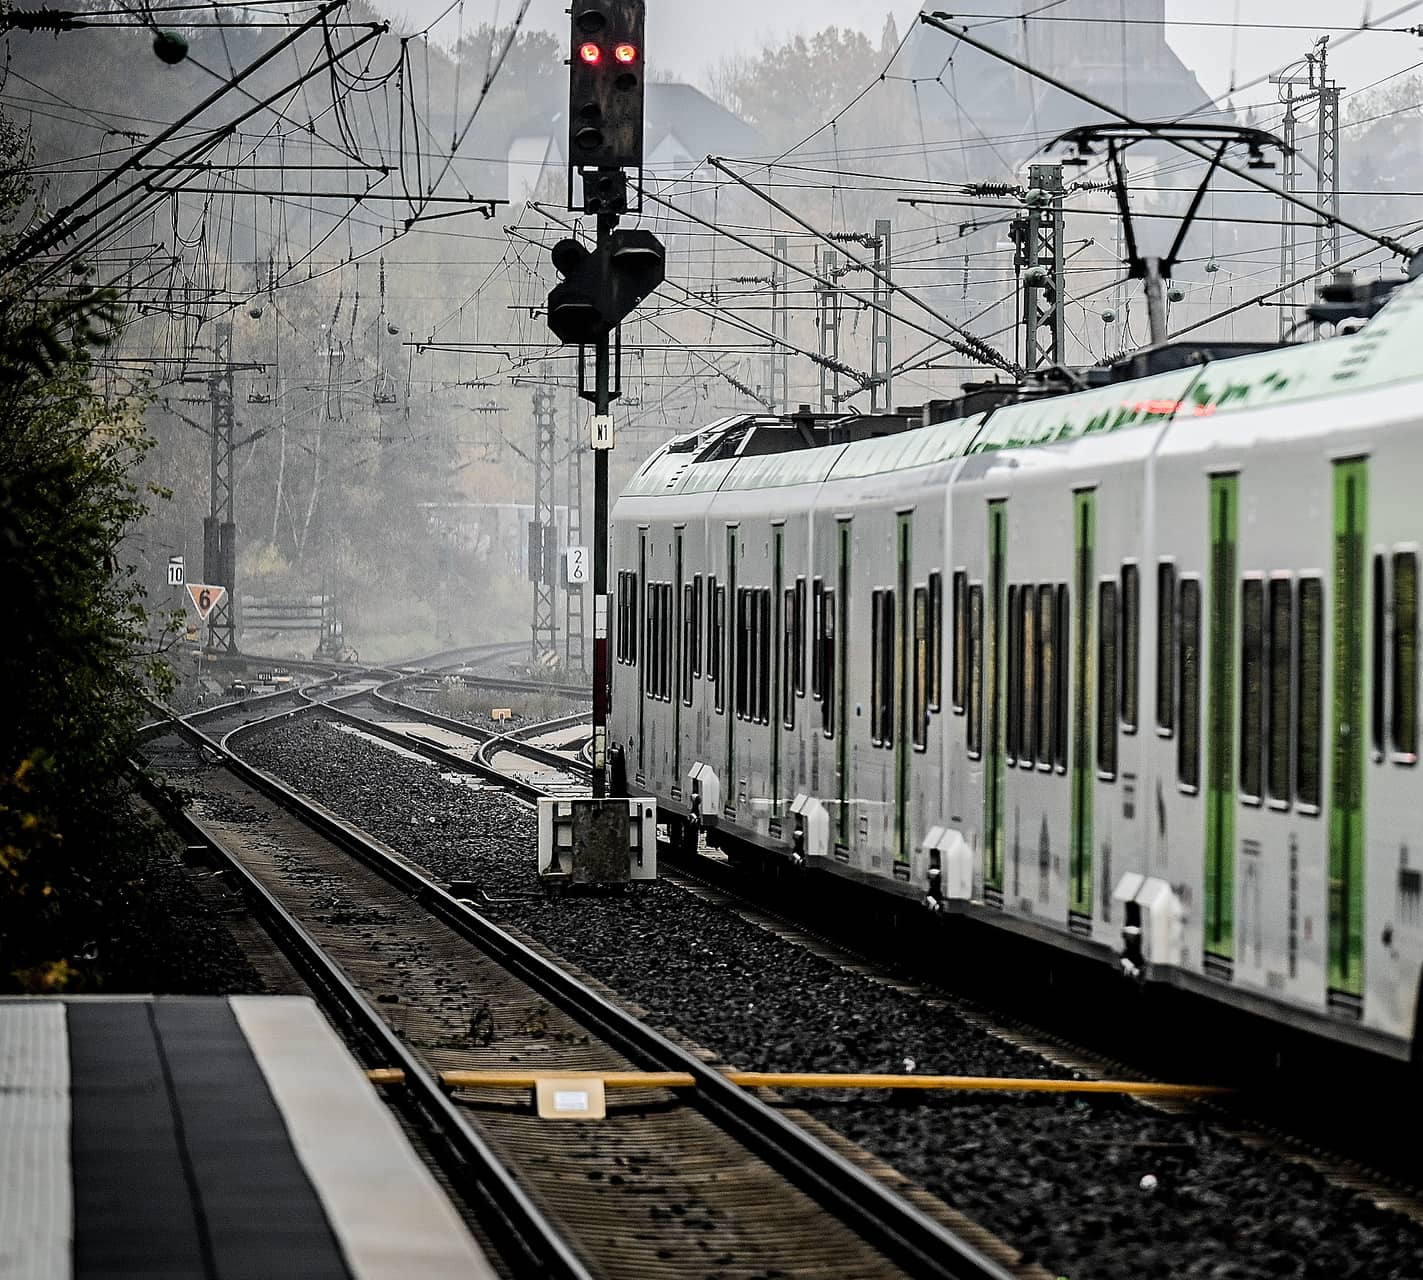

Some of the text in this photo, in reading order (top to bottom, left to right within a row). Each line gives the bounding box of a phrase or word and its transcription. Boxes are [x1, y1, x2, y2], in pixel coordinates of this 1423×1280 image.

[597, 424, 608, 441] N1
[574, 550, 583, 564] 2
[169, 567, 183, 582] 10
[573, 565, 583, 579] 6
[199, 589, 211, 609] 6
